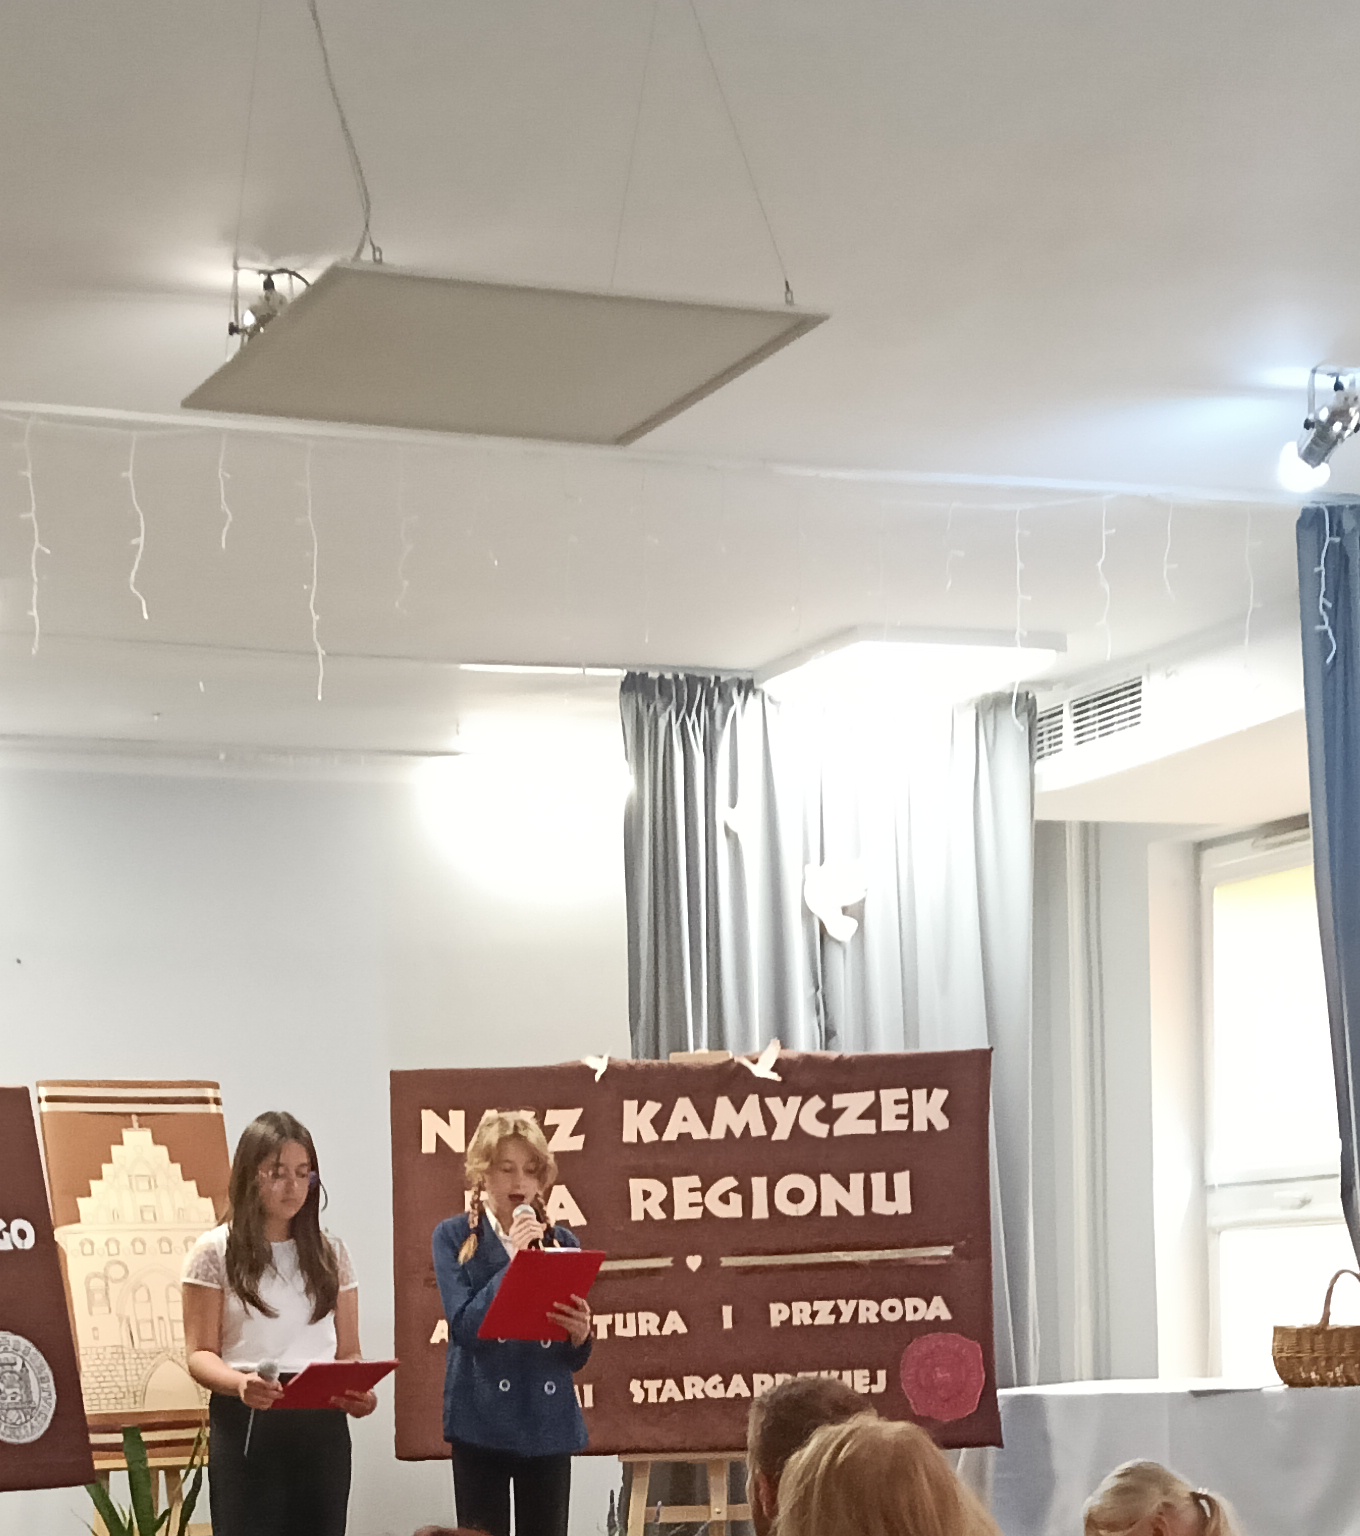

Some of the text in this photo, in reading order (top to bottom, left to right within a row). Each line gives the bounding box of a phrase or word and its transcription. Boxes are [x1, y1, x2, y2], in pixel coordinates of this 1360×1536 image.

[421, 1087, 950, 1154] NZ KAMYCZEK
[628, 1170, 912, 1222] REGIONU
[722, 1305, 733, 1330] I
[769, 1295, 952, 1328] PRZYRODA
